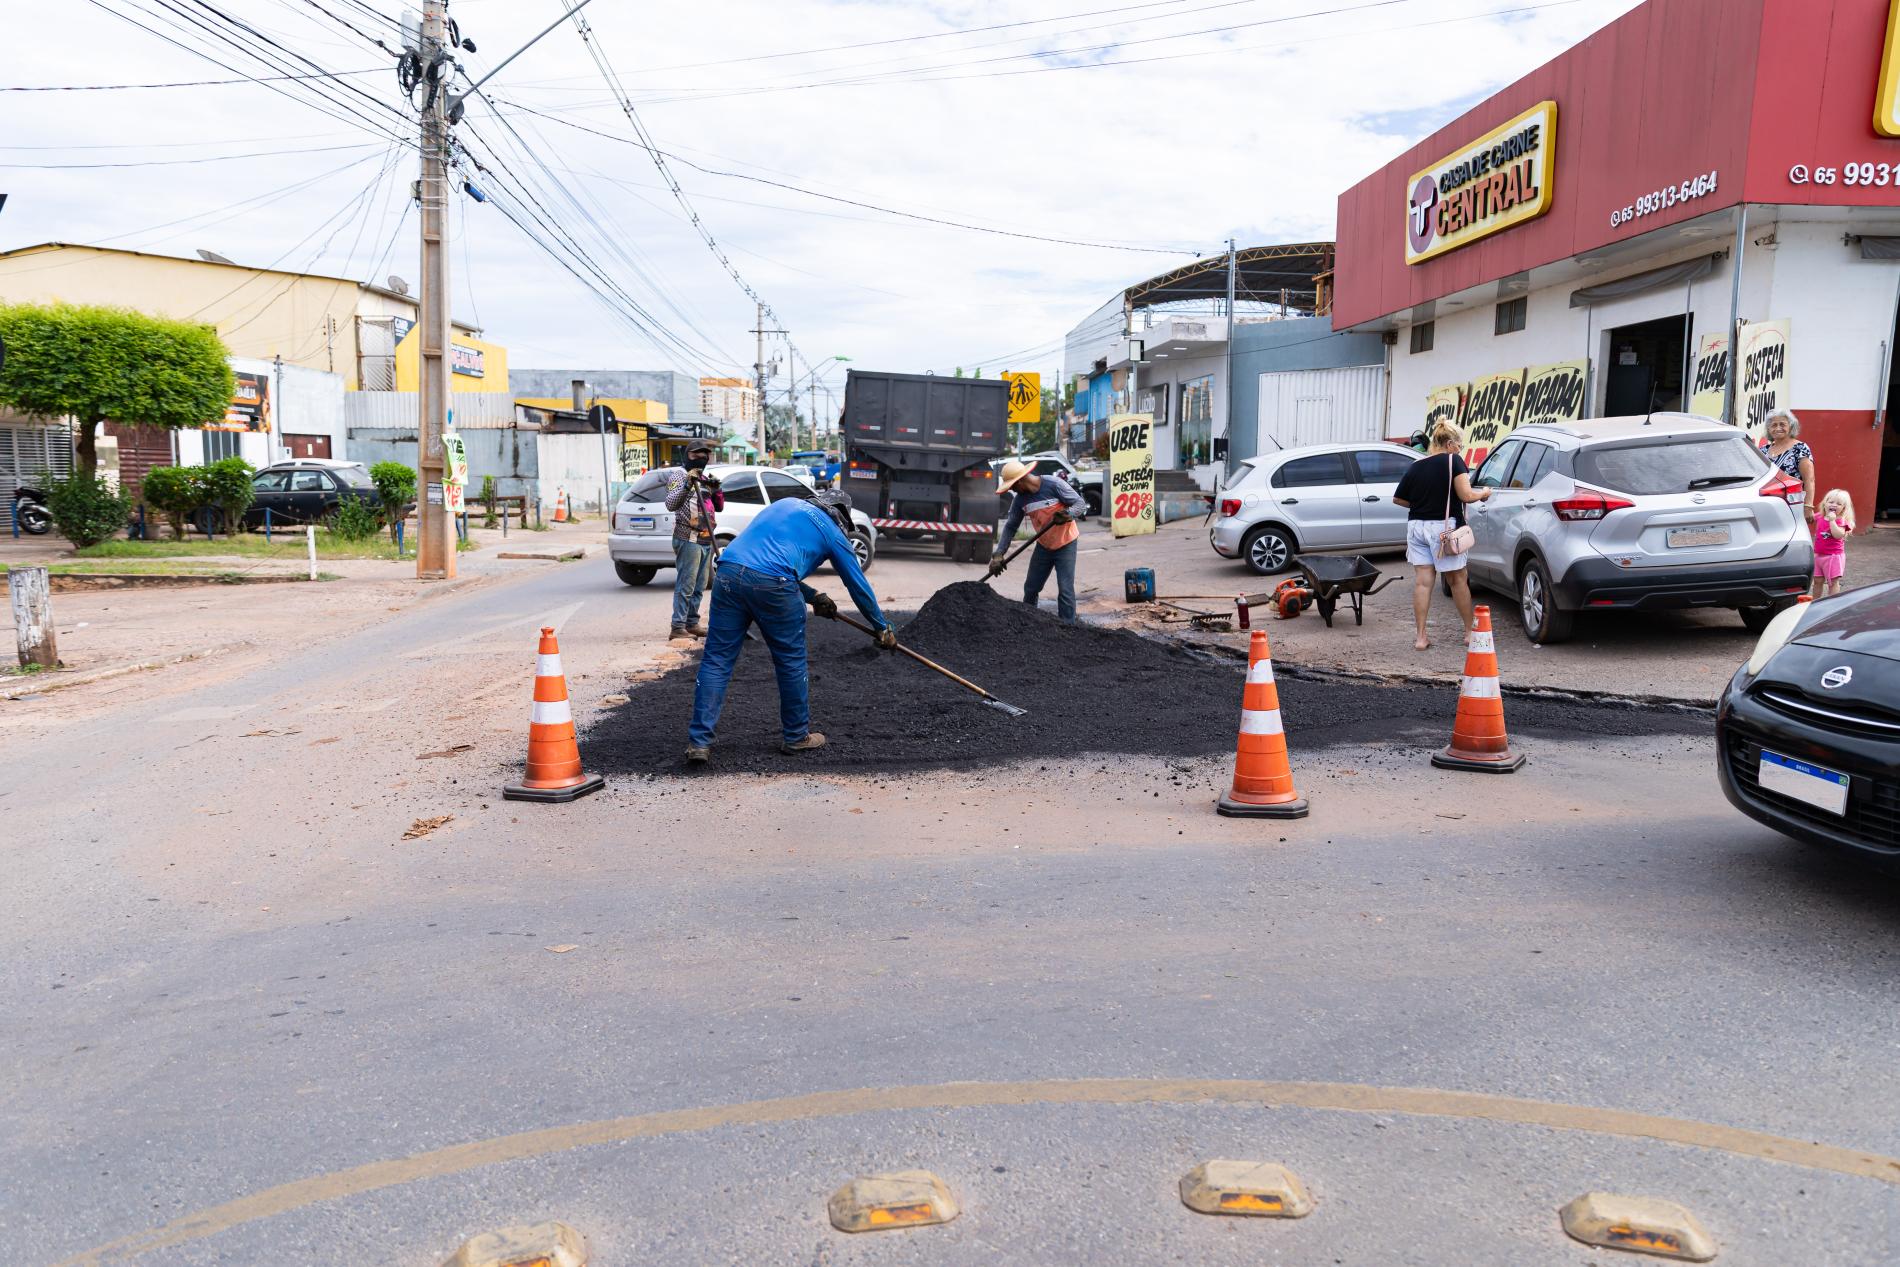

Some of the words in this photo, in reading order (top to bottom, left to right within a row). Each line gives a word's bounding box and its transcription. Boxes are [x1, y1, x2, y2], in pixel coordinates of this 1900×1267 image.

[1439, 161, 1472, 194] CASA
[1471, 150, 1491, 178] DE
[1490, 125, 1540, 169] CARNE
[1813, 166, 1836, 185] 65
[1435, 159, 1539, 237] CENTRAL
[1621, 207, 1634, 223] 65
[1635, 170, 1718, 217] 99313-6464
[1743, 343, 1785, 392] BISTECA
[1466, 379, 1521, 427] CARNE
[1111, 423, 1150, 453] UBRE
[1120, 482, 1149, 492] BOVINA
